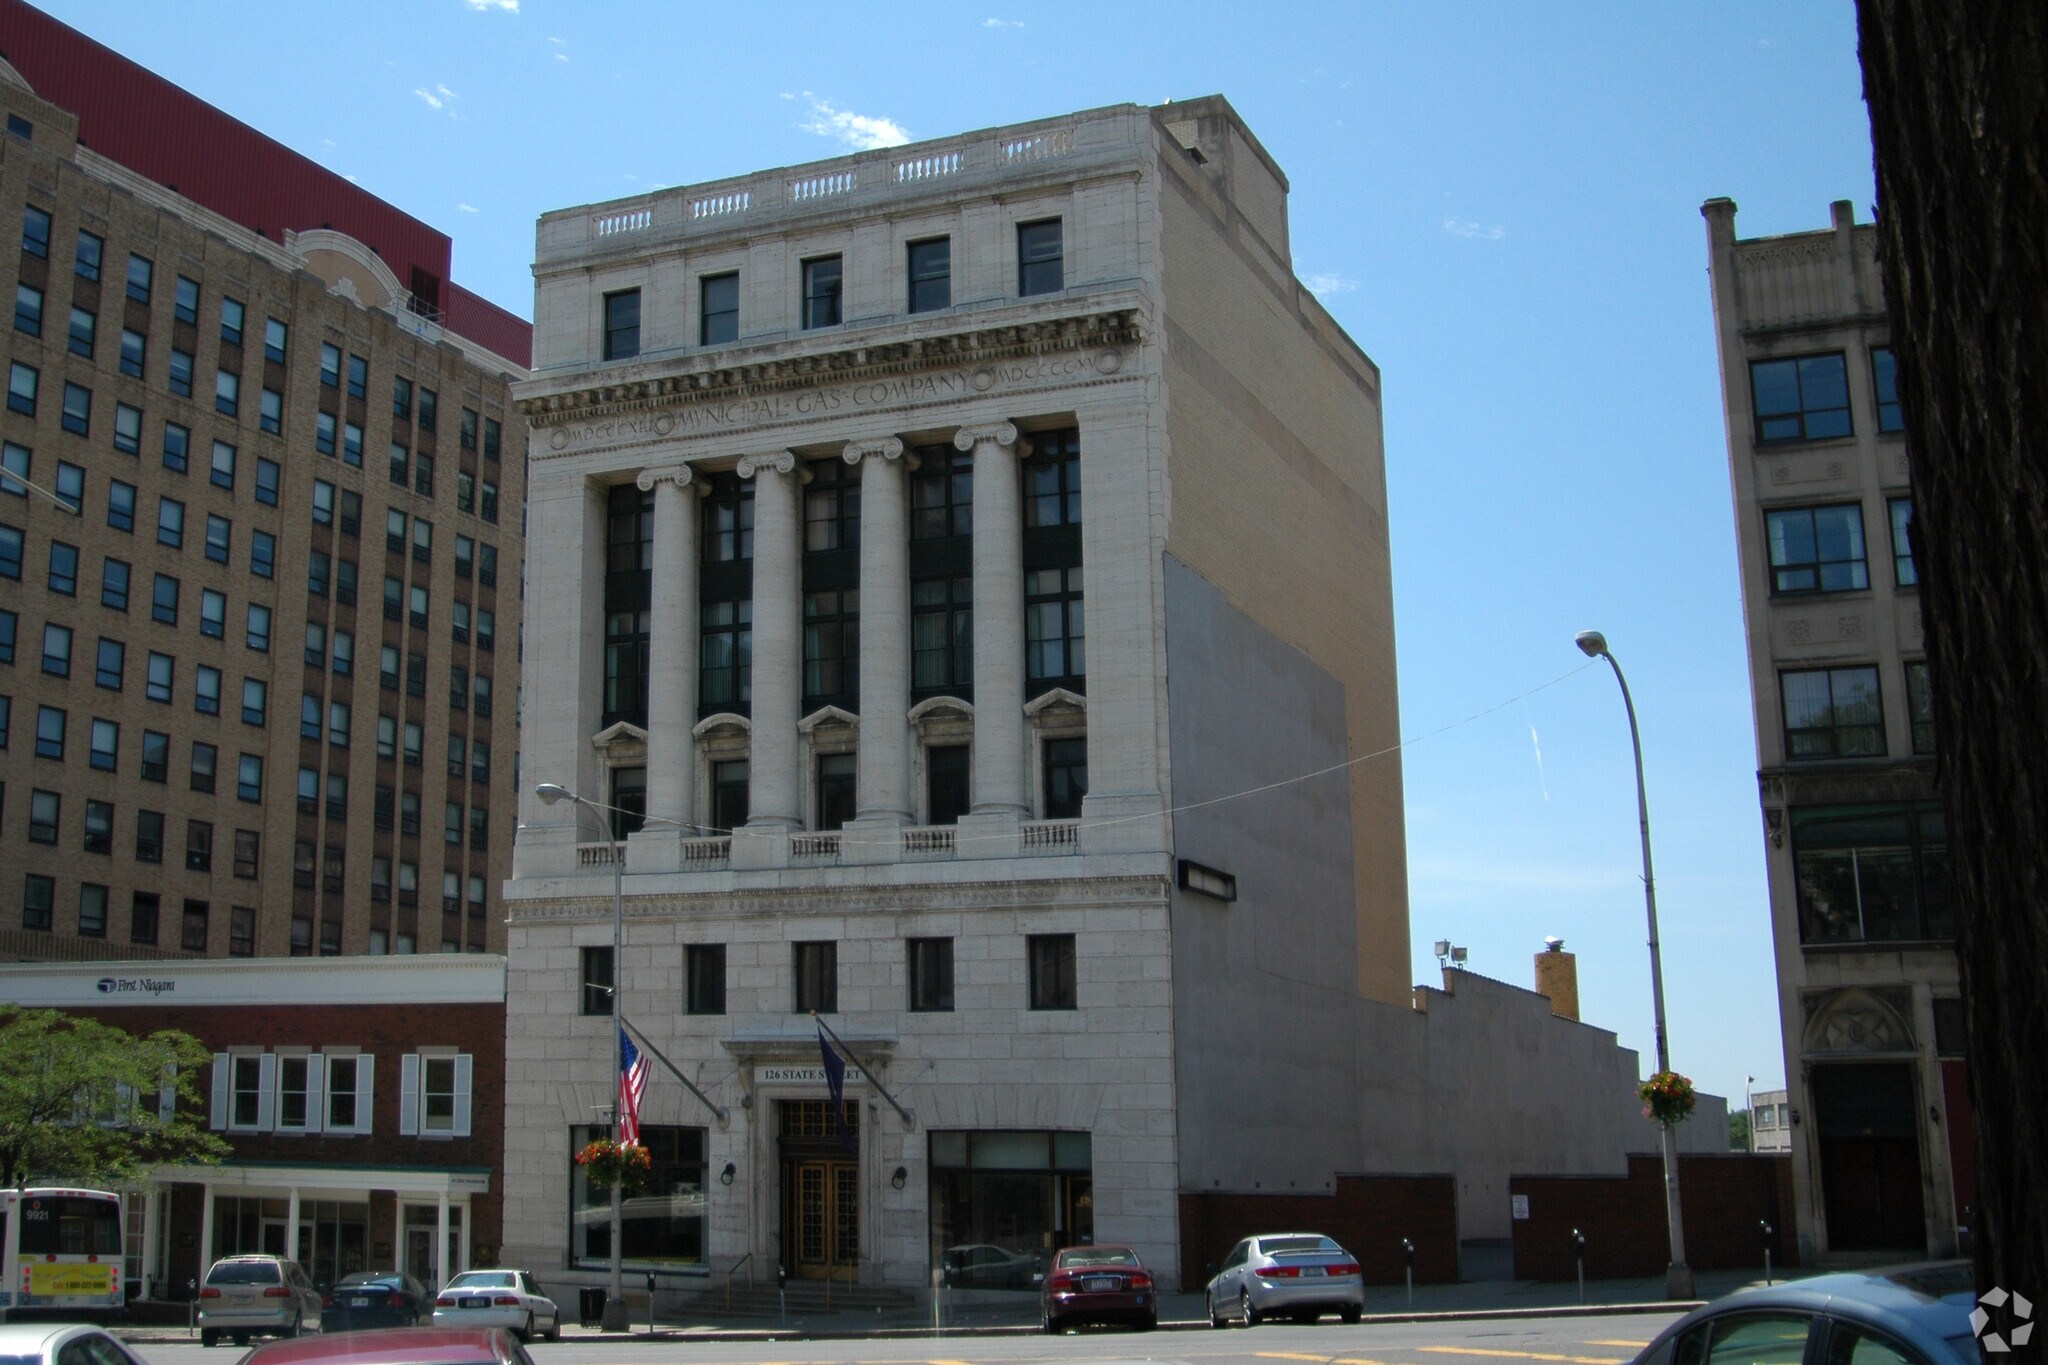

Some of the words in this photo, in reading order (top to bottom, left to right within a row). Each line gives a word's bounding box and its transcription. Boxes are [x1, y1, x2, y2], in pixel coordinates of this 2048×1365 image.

[795, 389, 842, 414] GAS
[852, 370, 972, 405] COMPANY
[117, 979, 138, 992] First
[140, 979, 176, 996] Niagara
[765, 1069, 780, 1080] 126
[782, 1069, 816, 1080] STATE
[26, 1210, 49, 1220] 9921
